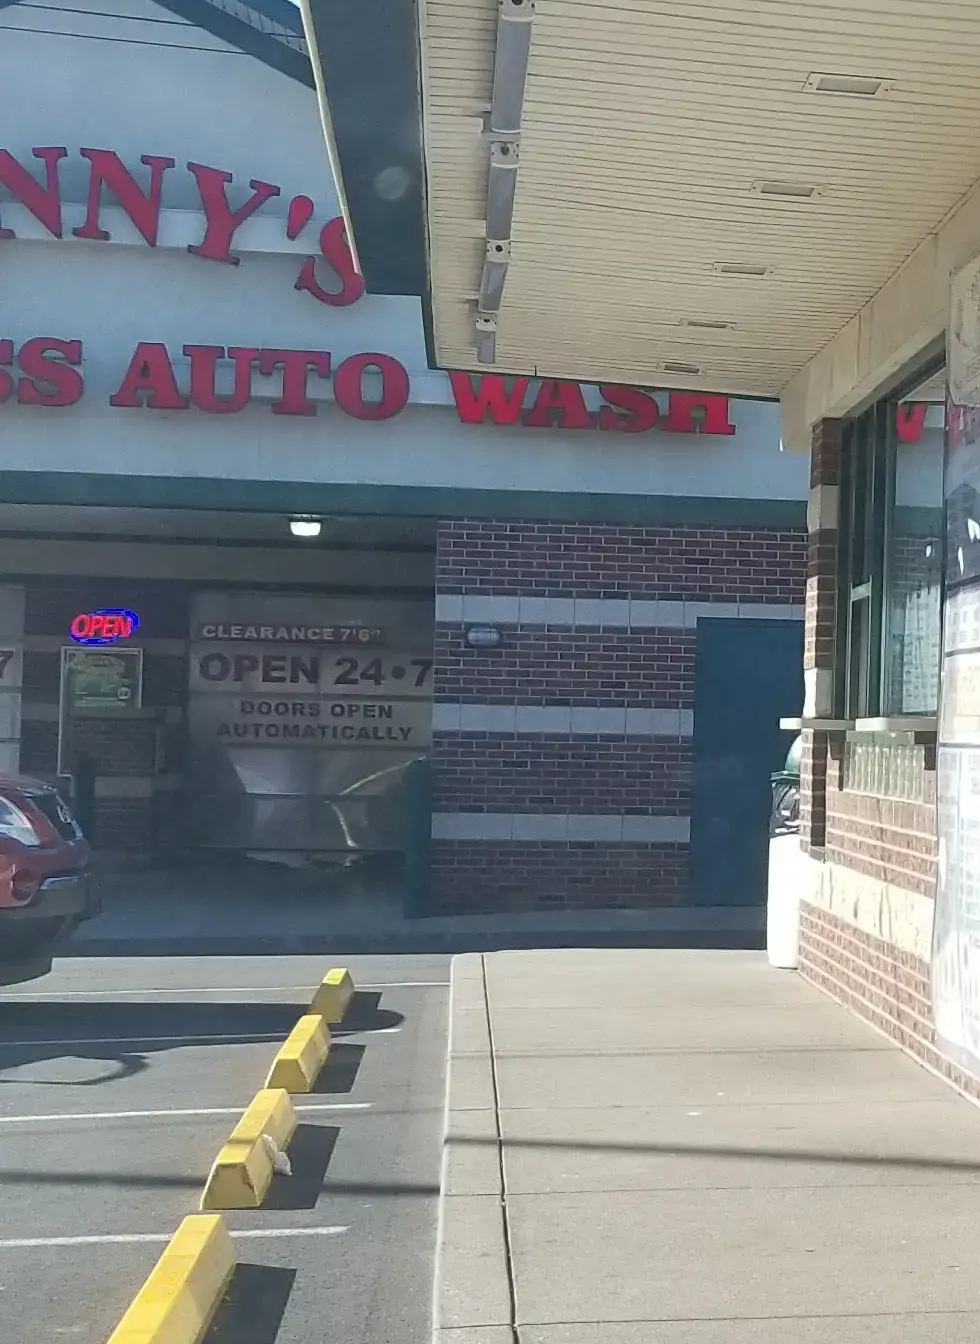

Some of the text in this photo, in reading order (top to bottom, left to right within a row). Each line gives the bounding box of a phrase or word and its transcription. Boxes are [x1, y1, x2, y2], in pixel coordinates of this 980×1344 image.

[0, 336, 736, 436] S AUTO WASH
[70, 612, 134, 639] OPEN
[201, 624, 335, 641] CLEARANCE
[199, 652, 320, 685] OPEN
[240, 700, 394, 720] DOORS OPEN
[216, 722, 415, 742] AUTOMATICALLY
